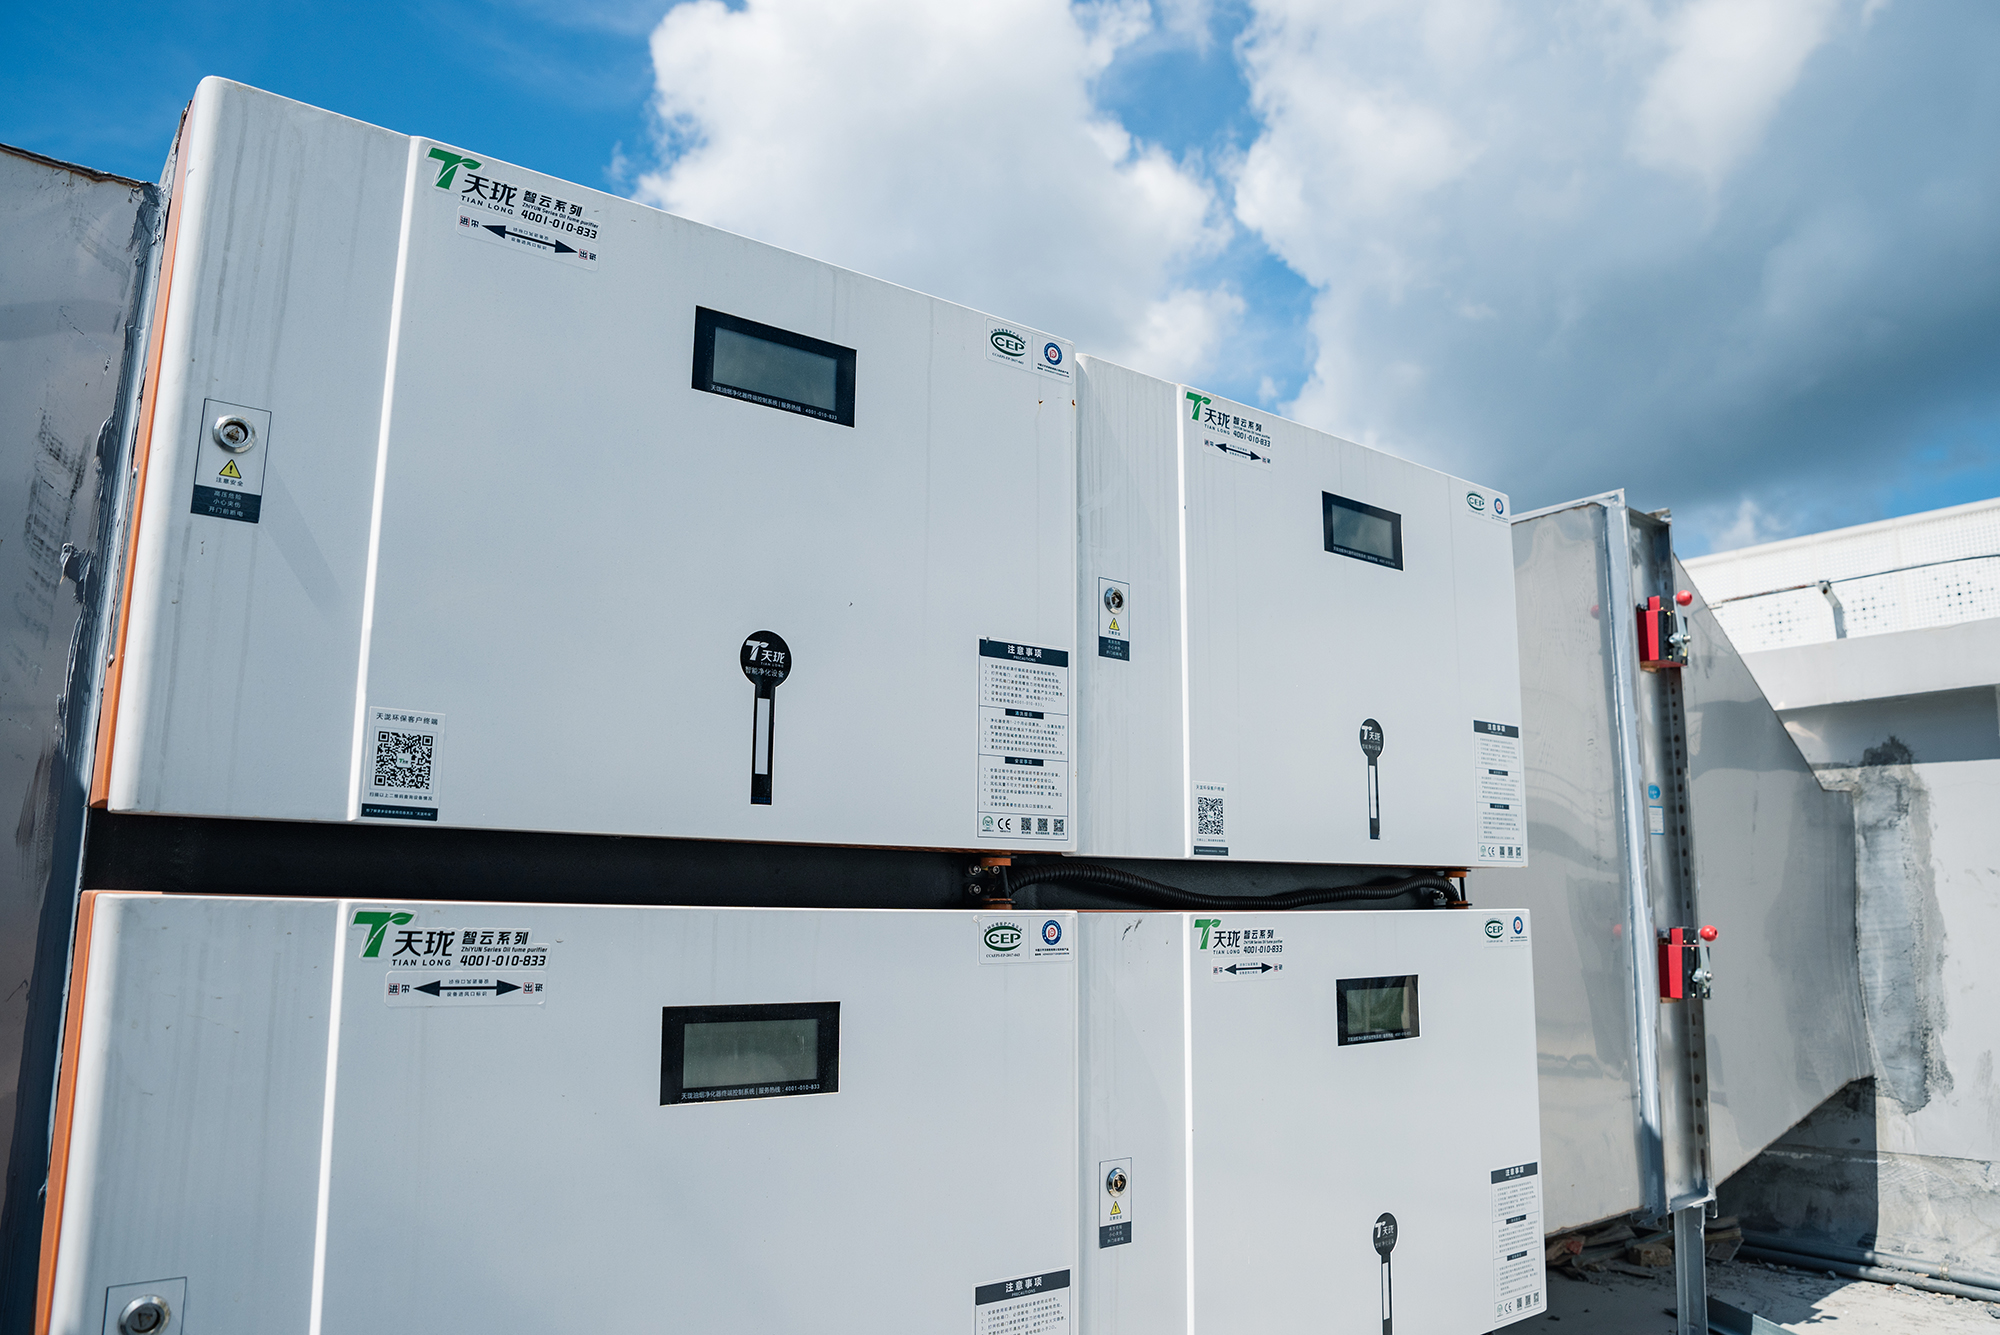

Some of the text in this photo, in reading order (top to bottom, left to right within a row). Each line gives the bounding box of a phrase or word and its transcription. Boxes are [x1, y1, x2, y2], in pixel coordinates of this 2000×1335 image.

[462, 173, 517, 208] 天珑
[461, 194, 514, 215] TIAN LONG
[523, 190, 583, 217] 智云系列
[521, 209, 598, 240] 4001-010-833
[542, 207, 558, 216] Series
[566, 213, 579, 222] fume
[579, 218, 599, 230] purifier
[995, 336, 1025, 352] CEP
[1204, 407, 1230, 430] 天珑
[1233, 416, 1262, 432] 智云系列
[1204, 423, 1216, 431] TIAN
[1217, 427, 1230, 436] LONG
[1233, 430, 1271, 448] 4001-010-833
[216, 477, 243, 487] 注意安全
[761, 649, 785, 664] 天珑
[1007, 644, 1042, 658] 注意事项
[1243, 929, 1274, 940] 智云系列
[1487, 925, 1504, 934] CEP
[392, 930, 455, 957] 天珑
[462, 931, 529, 945] 智云系列
[989, 933, 1021, 945] CEP
[1213, 930, 1240, 949] 天珑
[527, 946, 548, 954] purifier
[1243, 945, 1283, 954] 4001-010-833
[392, 959, 451, 967] TIAN LONG
[460, 955, 546, 967] 4001-010-833
[1005, 1276, 1042, 1293] 注意事项
